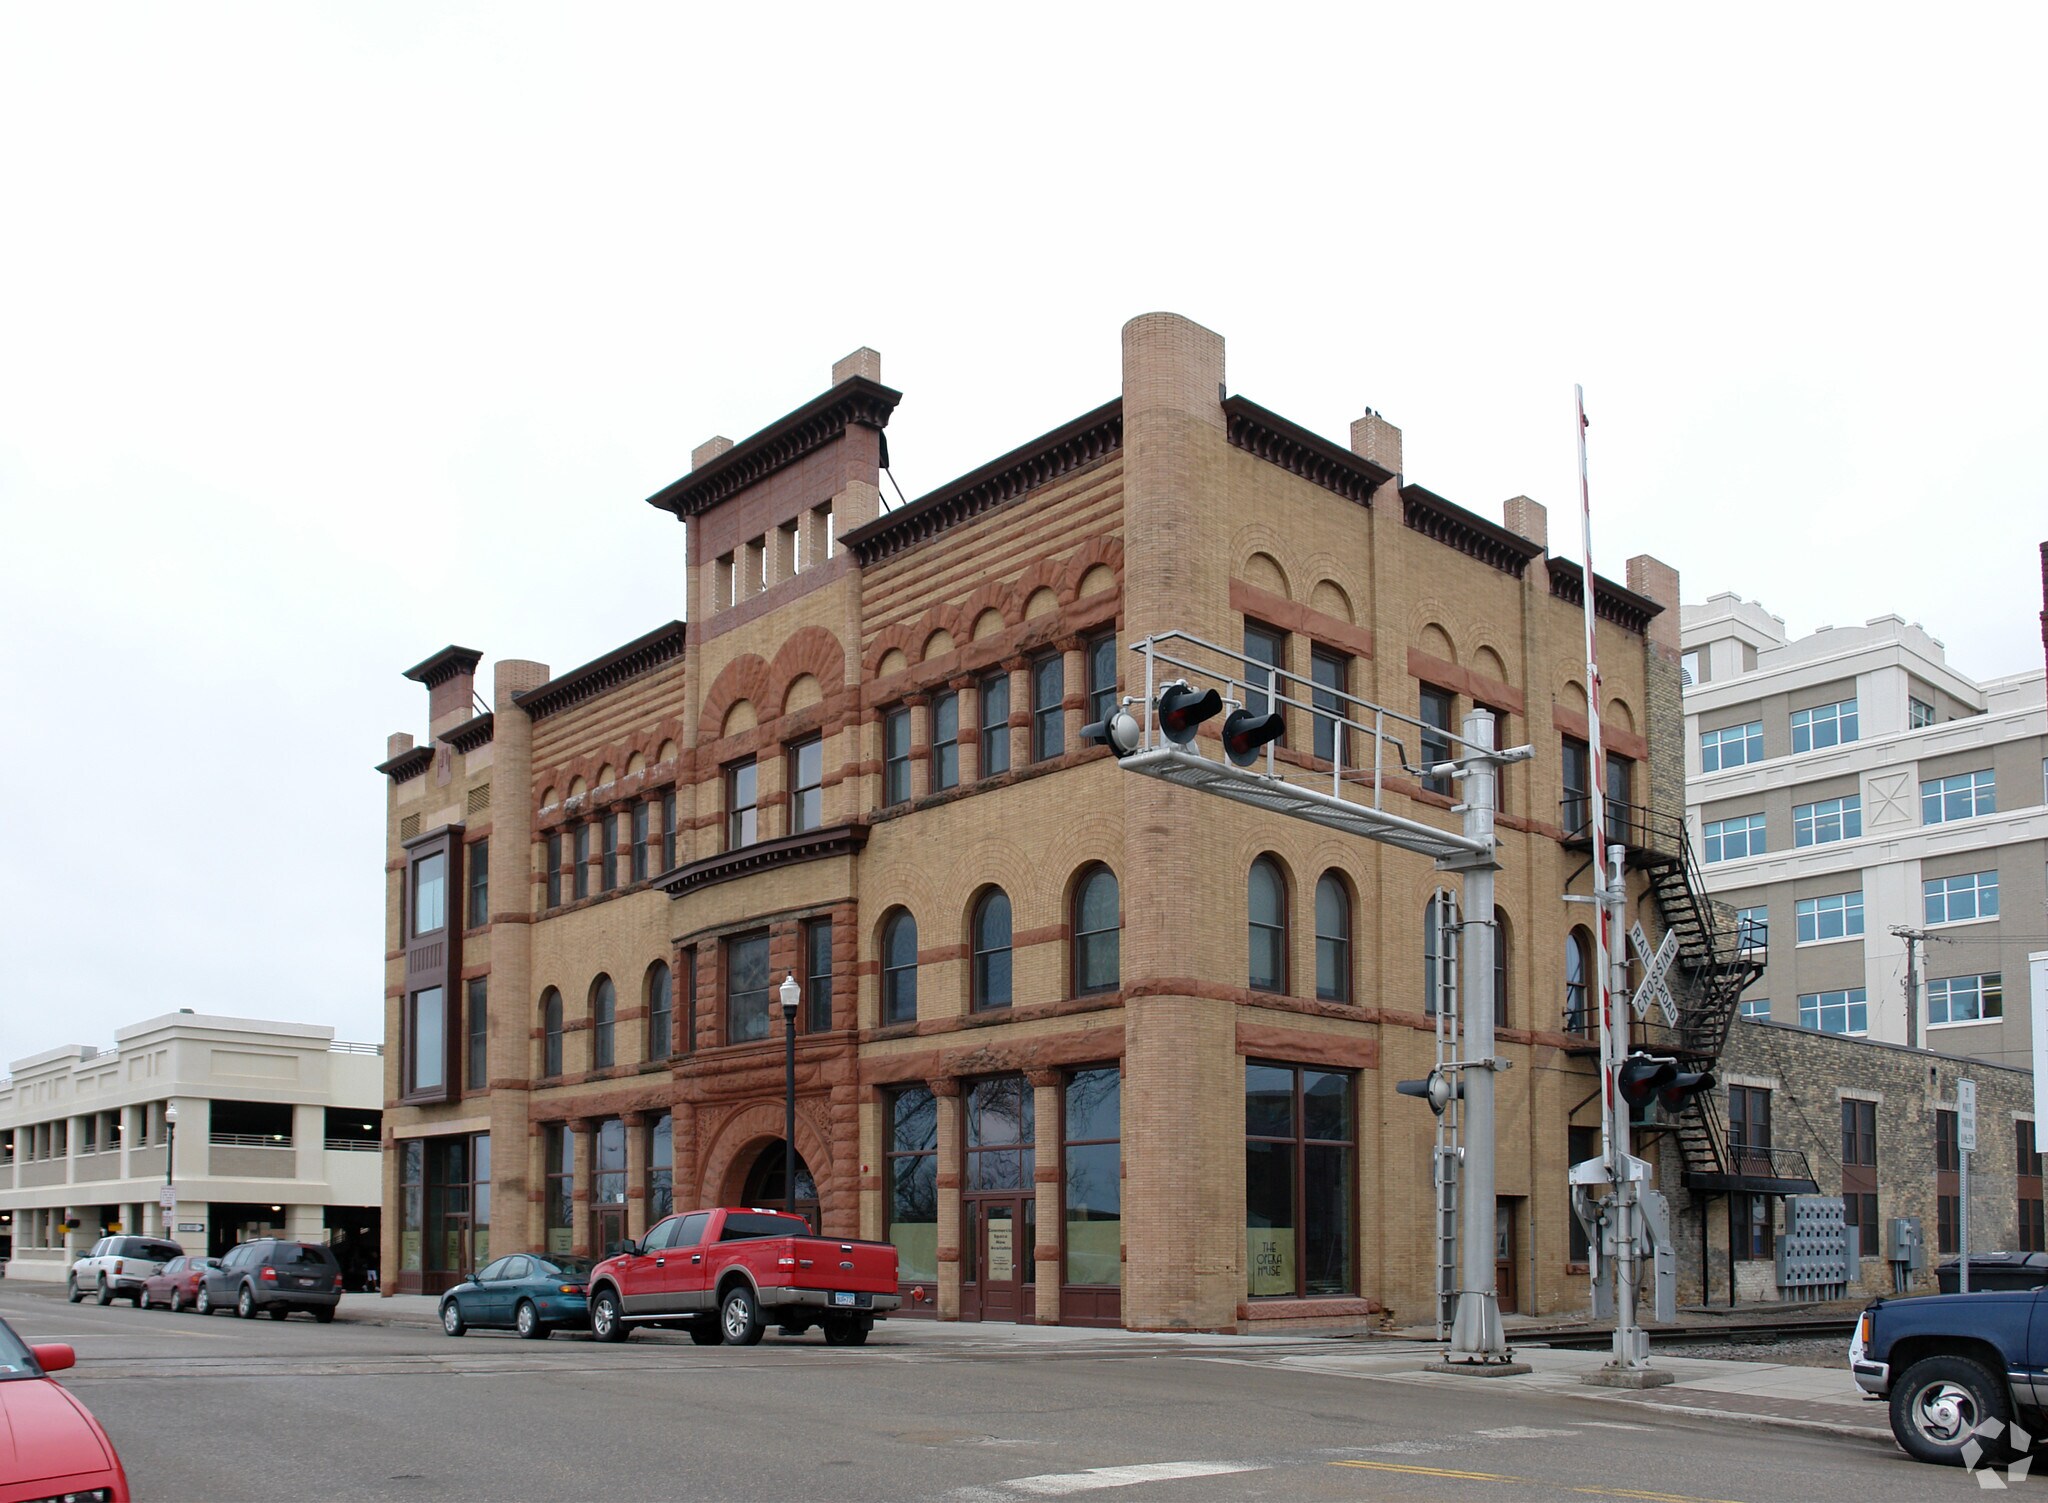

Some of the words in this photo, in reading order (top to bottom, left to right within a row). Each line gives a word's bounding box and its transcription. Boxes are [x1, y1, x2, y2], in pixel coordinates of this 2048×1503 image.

[1632, 926, 1651, 968] RAIL
[1657, 983, 1677, 1021] ROAD
[1637, 940, 1676, 1014] CROSSING
[1256, 1253, 1283, 1265] OPERA
[1262, 1241, 1277, 1253] THE
